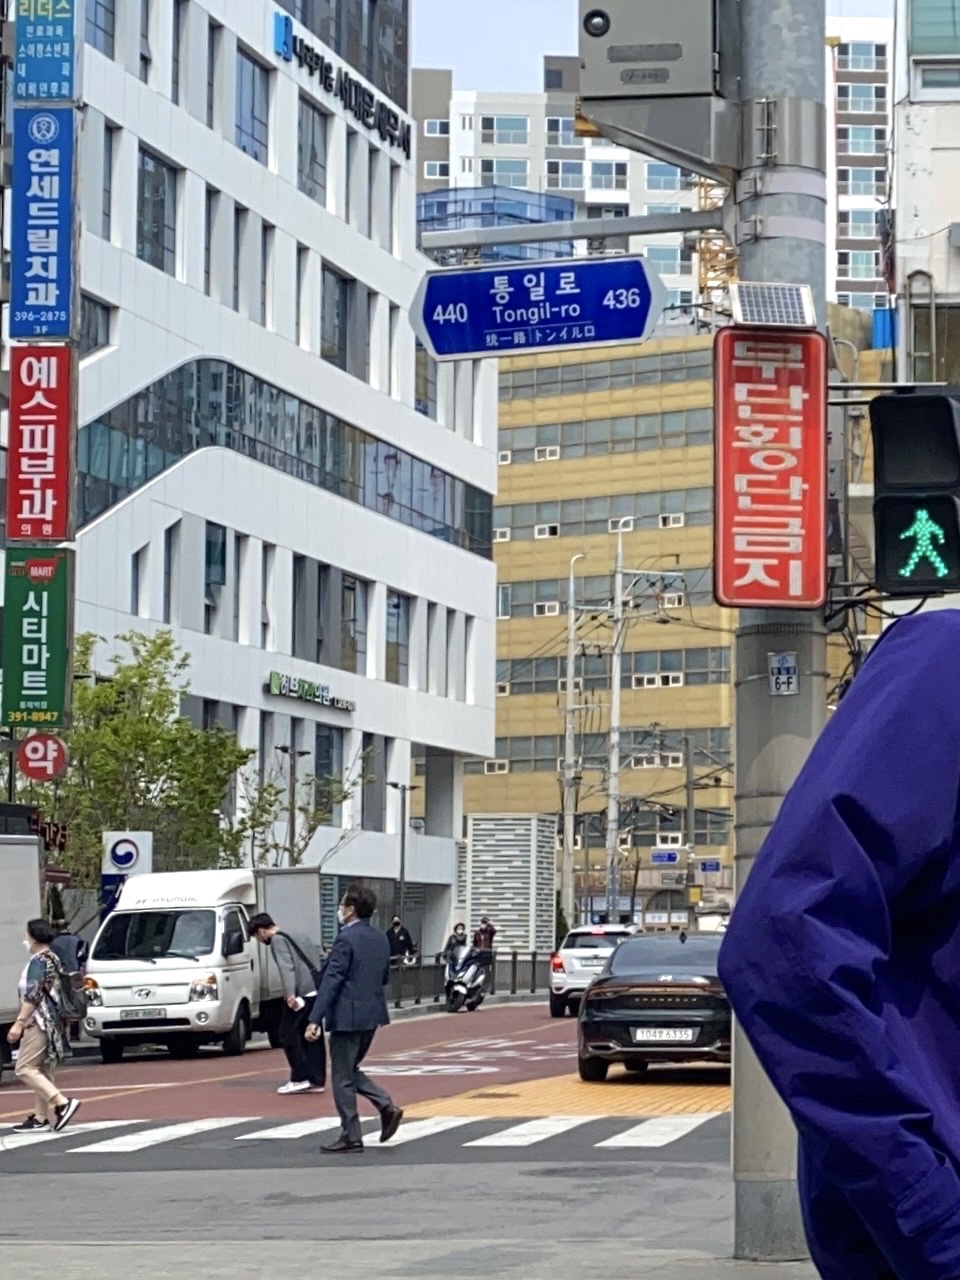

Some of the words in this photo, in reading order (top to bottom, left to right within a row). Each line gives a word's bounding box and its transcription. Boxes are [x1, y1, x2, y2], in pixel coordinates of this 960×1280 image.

[18, 0, 71, 21] 리더스
[17, 81, 70, 97] 이비인후과
[24, 148, 60, 307] 연세드림치과
[489, 272, 580, 304] 통일로
[602, 288, 641, 310] 436
[14, 311, 67, 322] 396-2875
[432, 302, 468, 325] 440
[492, 302, 581, 324] Tongil-ro
[33, 325, 49, 335] 3F
[17, 356, 58, 521] 예스피부과
[732, 340, 809, 597] 무단횡단금지
[30, 566, 53, 577] MART
[21, 590, 51, 696] 시티마트
[775, 676, 793, 691] 6-F
[24, 739, 59, 775] 약
